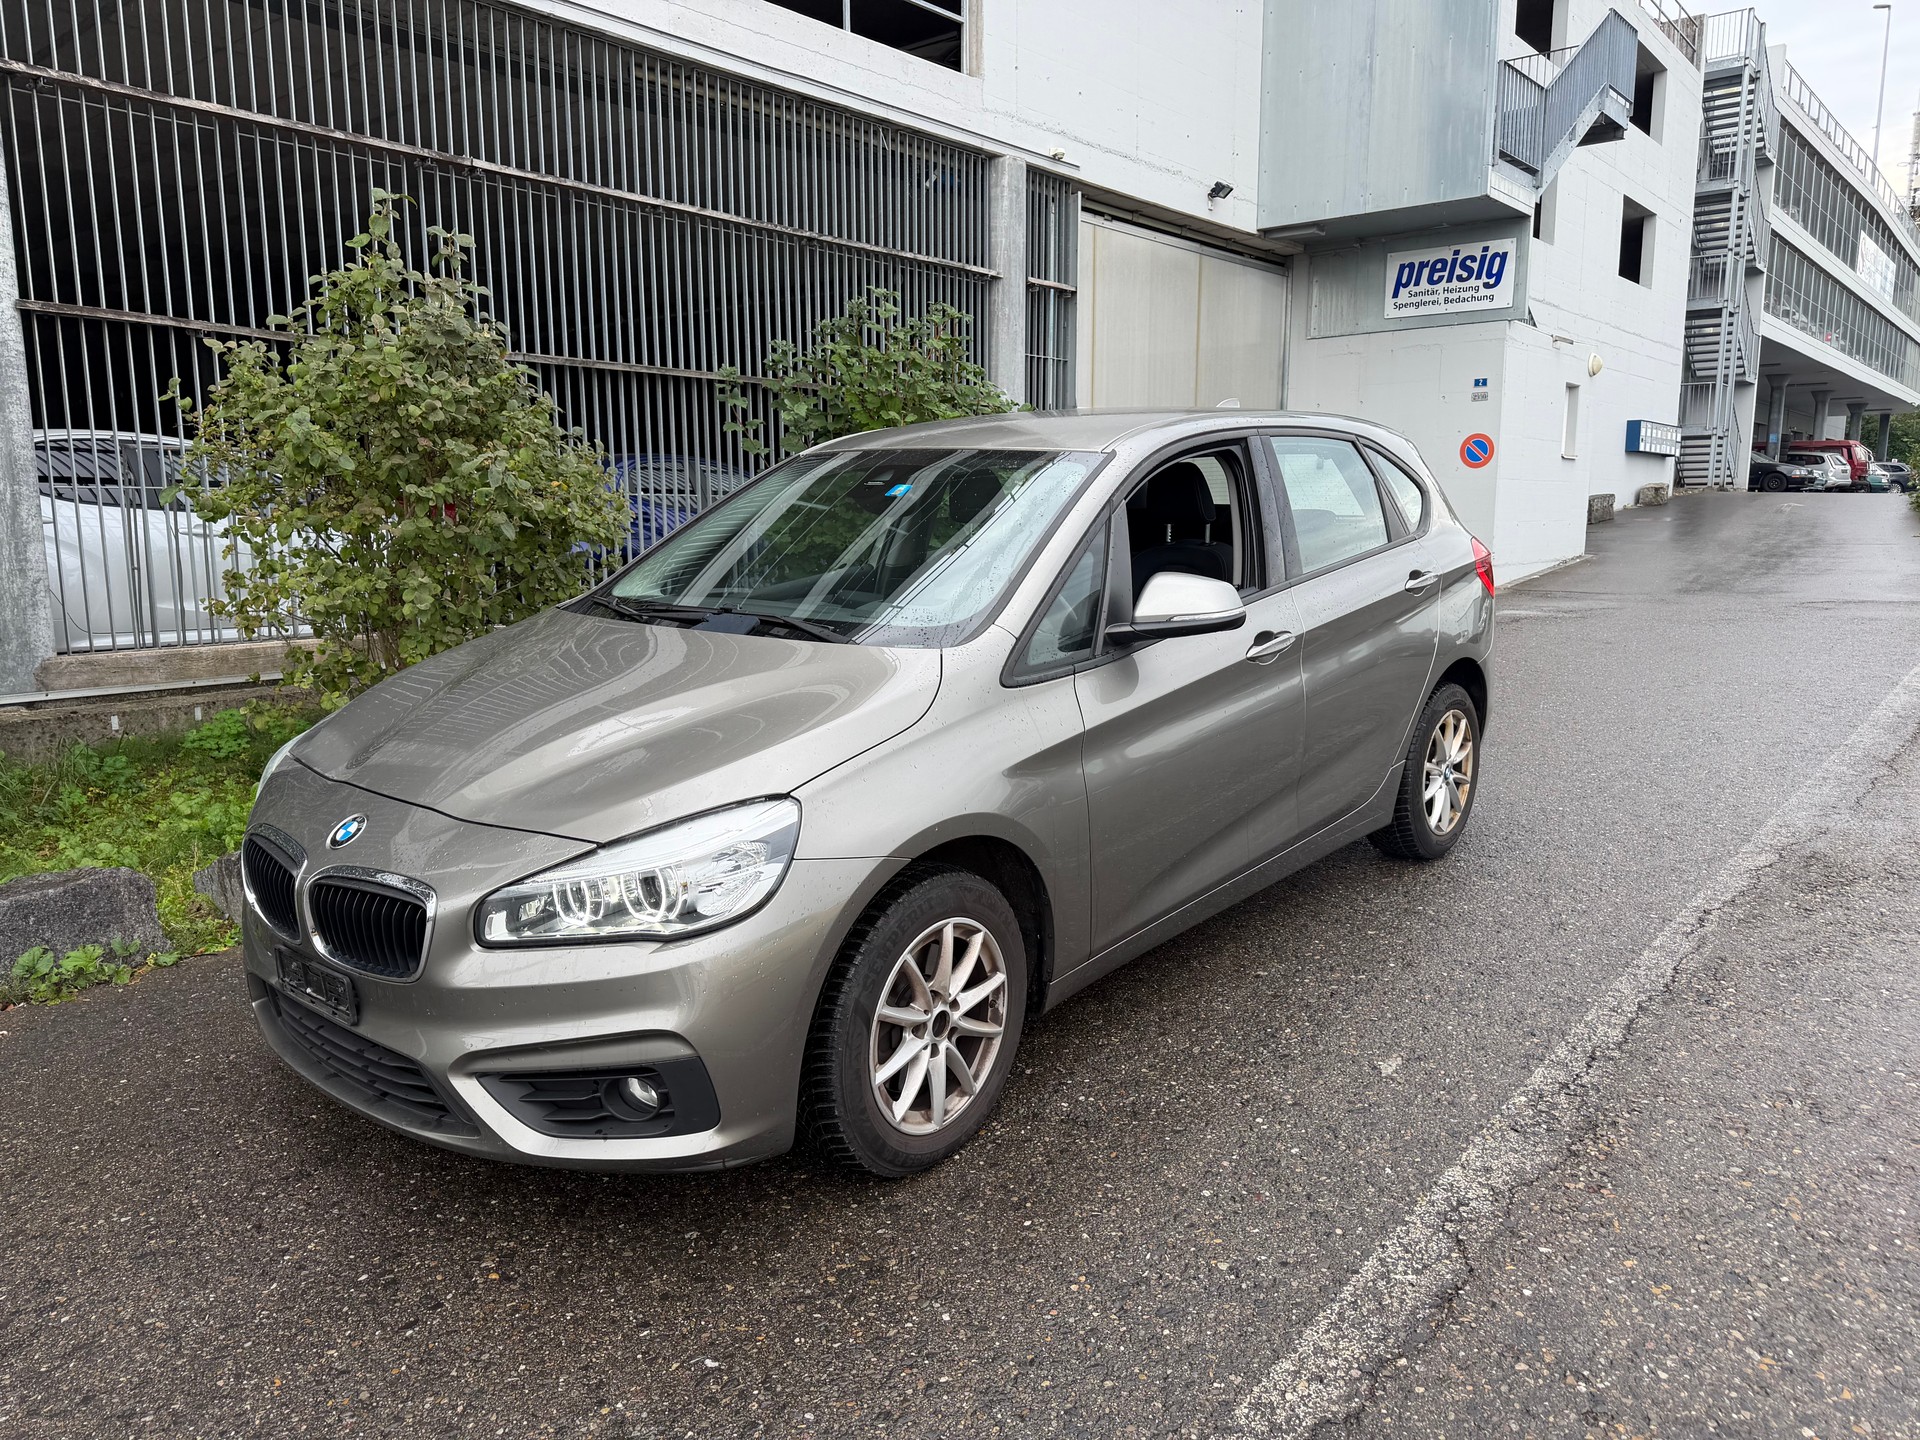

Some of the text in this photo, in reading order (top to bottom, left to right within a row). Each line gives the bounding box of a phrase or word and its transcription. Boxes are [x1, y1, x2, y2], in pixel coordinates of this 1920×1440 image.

[1392, 246, 1508, 299] preisig
[1408, 285, 1480, 298] Sanitär, Heizung
[1393, 294, 1494, 311] Spenglerei, Bedachung
